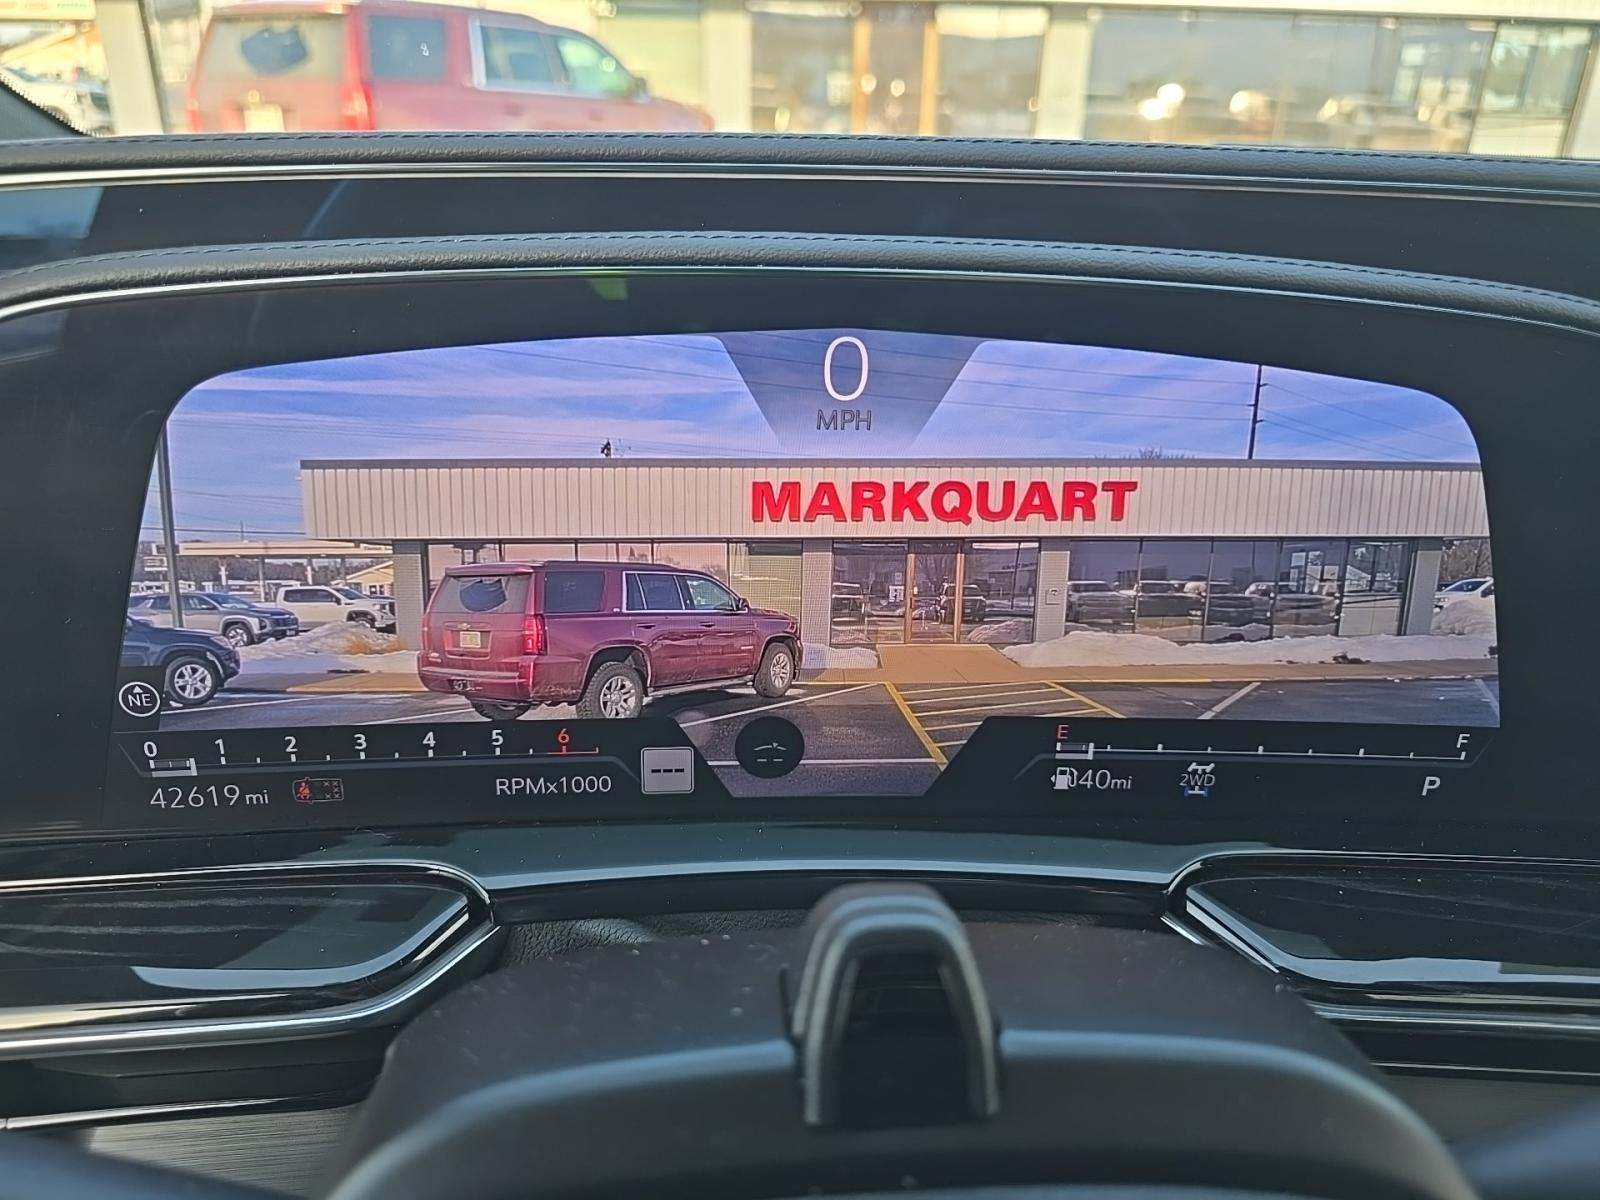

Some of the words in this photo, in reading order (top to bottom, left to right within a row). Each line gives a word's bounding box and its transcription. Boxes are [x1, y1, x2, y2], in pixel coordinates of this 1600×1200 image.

[823, 336, 868, 401] 0
[816, 409, 872, 431] MPH
[751, 480, 1138, 526] MARKQUART
[127, 693, 152, 708] NE
[1056, 724, 1069, 739] E
[1456, 733, 1470, 748] F
[143, 741, 158, 757] 0
[214, 738, 225, 755] 1
[284, 736, 298, 752] 2
[354, 733, 367, 750] 3
[422, 731, 436, 747] 4
[491, 729, 504, 746] 5
[558, 728, 570, 743] 6
[495, 775, 612, 796] RPMx1000
[1178, 773, 1216, 786] 2WD
[1421, 776, 1441, 796] P
